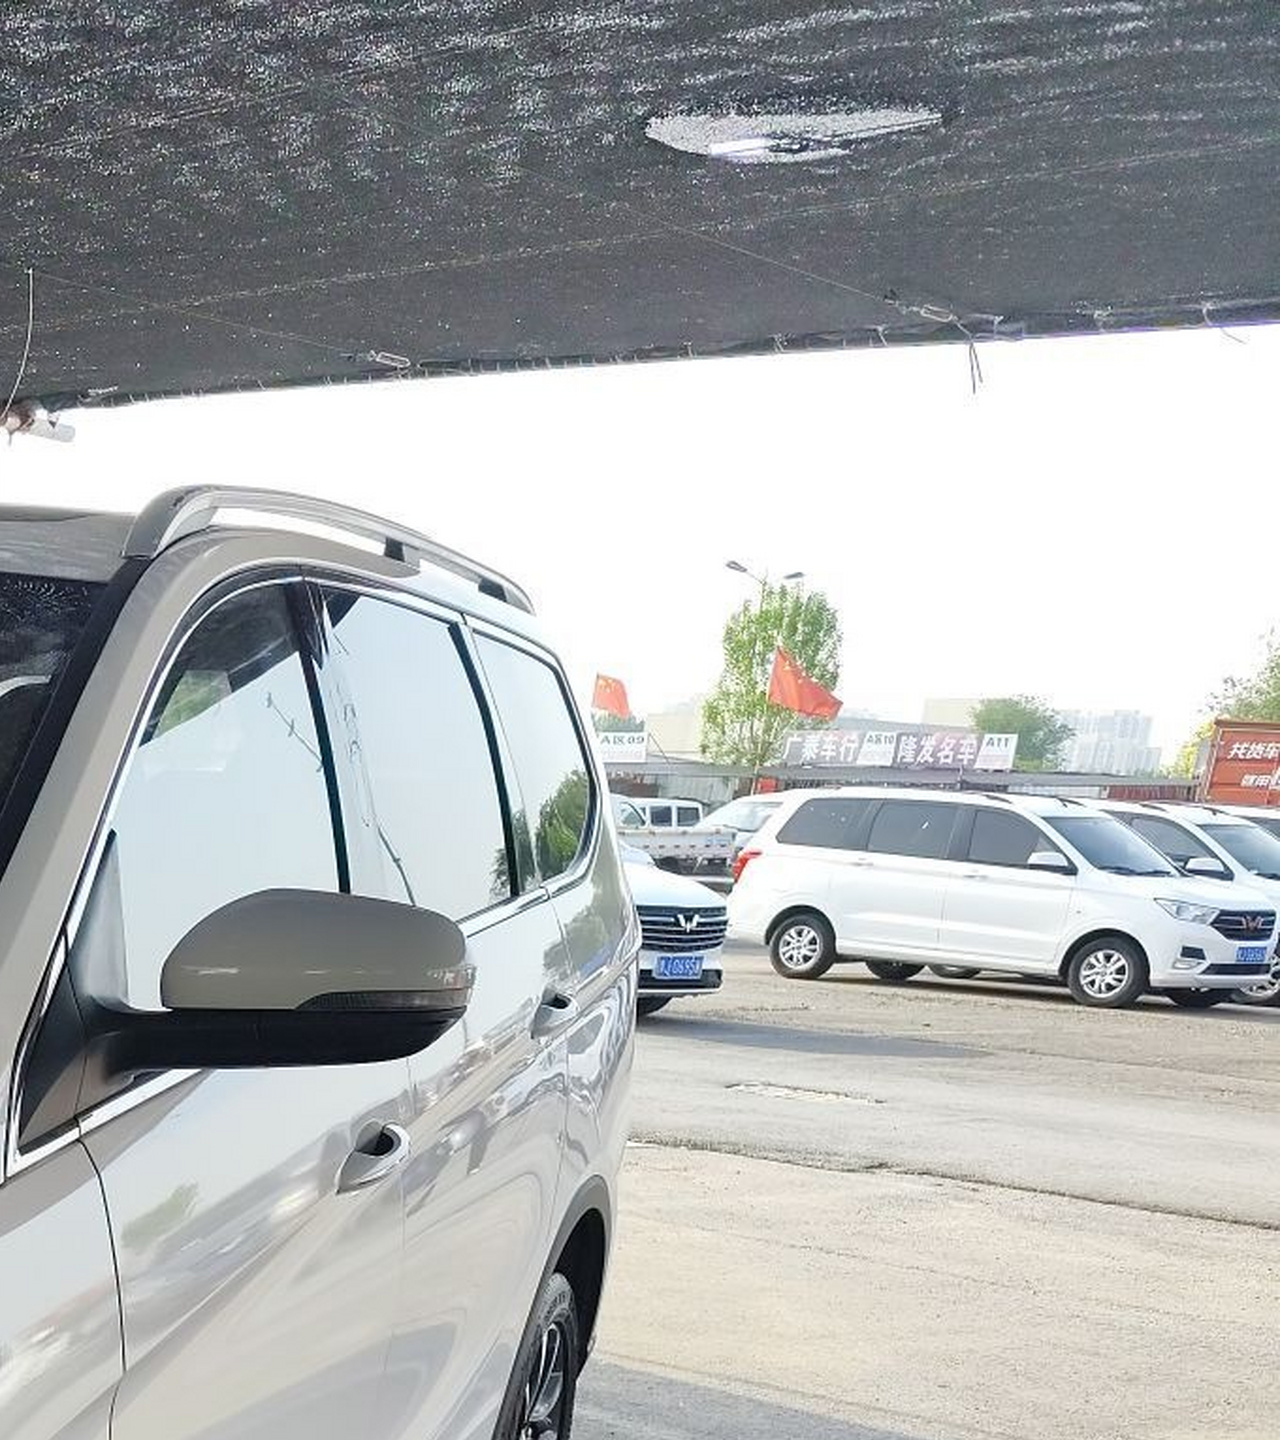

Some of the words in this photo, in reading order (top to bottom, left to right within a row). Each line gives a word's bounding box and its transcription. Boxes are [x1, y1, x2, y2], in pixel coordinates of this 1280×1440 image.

[600, 735, 645, 745] A区09
[898, 734, 975, 764] 隆发名车
